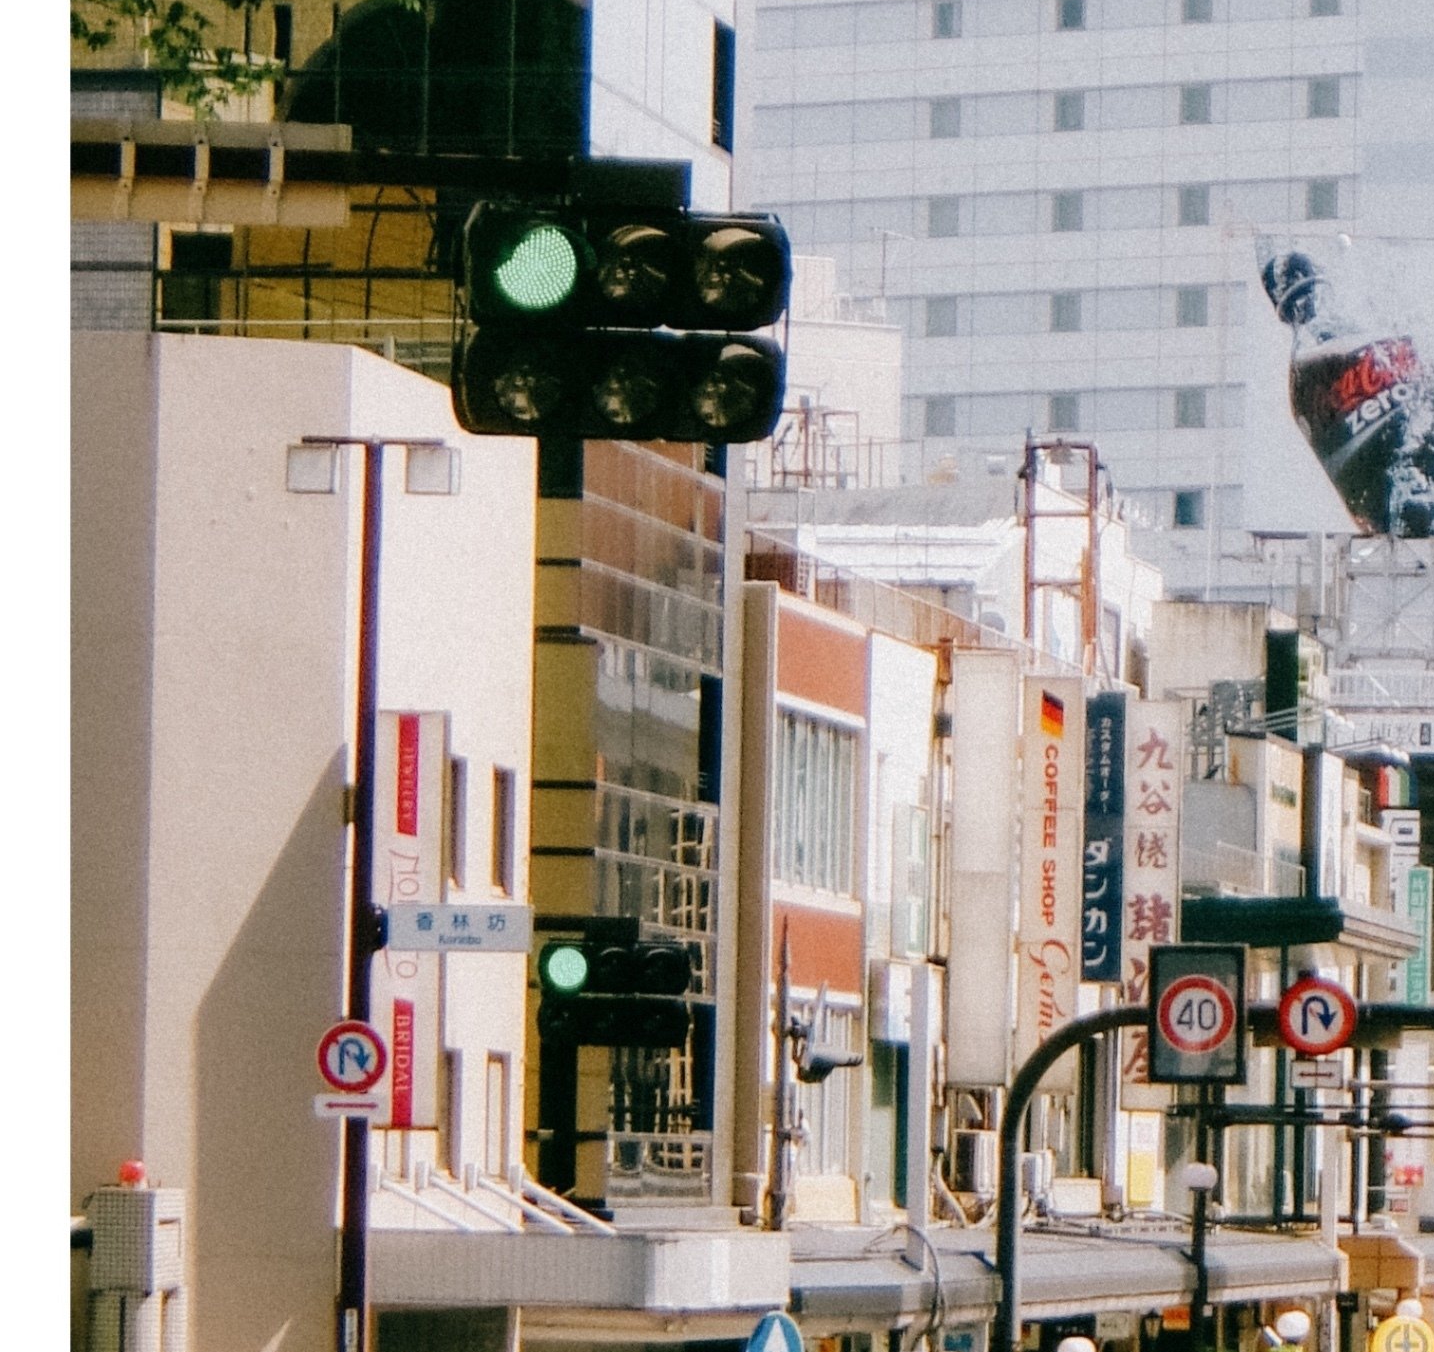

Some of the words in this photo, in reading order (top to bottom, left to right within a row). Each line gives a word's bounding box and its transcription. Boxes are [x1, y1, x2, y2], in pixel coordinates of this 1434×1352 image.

[1042, 743, 1059, 849] COFFEE
[416, 912, 506, 932] 香林坊
[1040, 858, 1058, 928] SHOP
[1084, 834, 1109, 967] ダンカン
[1176, 997, 1218, 1032] 40
